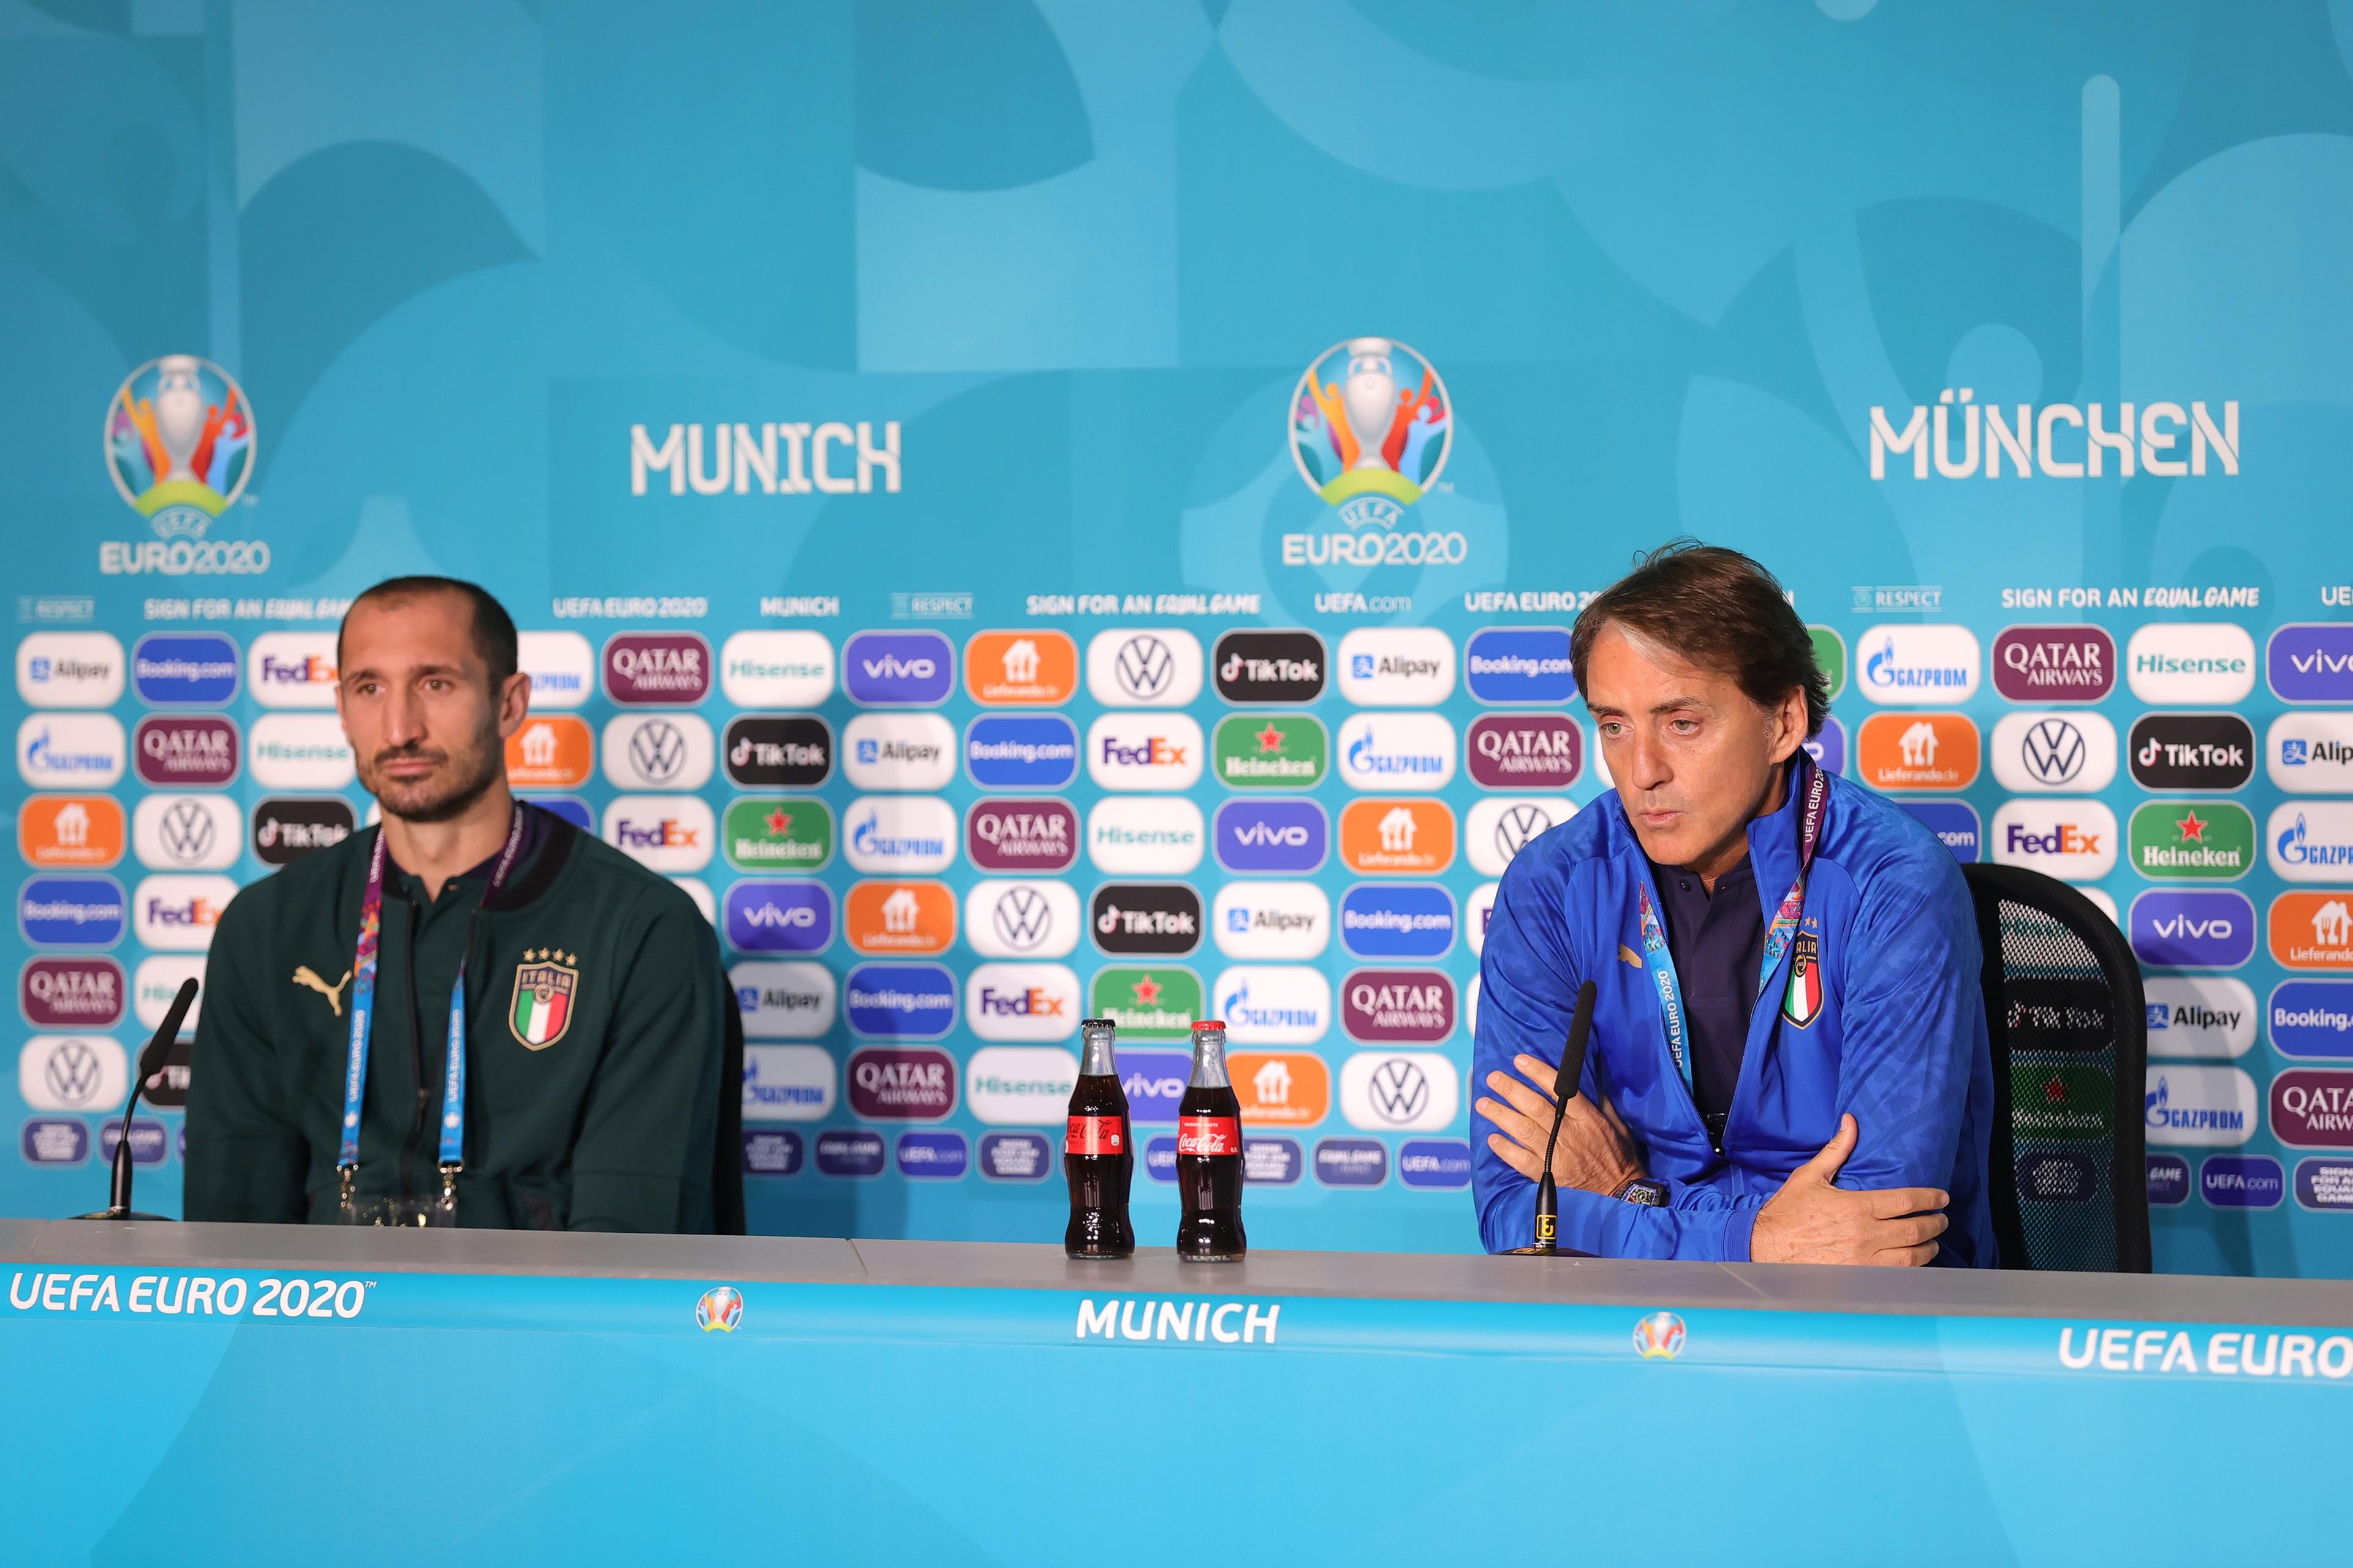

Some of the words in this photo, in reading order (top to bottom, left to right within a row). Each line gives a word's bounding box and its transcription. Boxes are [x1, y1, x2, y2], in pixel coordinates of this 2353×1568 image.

[1870, 387, 2240, 479] MÜNCHEN
[630, 420, 902, 496] MUNICH
[1341, 502, 1400, 526] UEFA
[553, 597, 604, 618] UEFA
[604, 597, 657, 618] EURO
[657, 597, 708, 618] 2020
[760, 596, 839, 616] MUNICH
[1026, 594, 1074, 615] SIGN
[1078, 594, 1119, 615] FOR
[1123, 594, 1152, 615] AN
[1154, 593, 1209, 615] EQUAL
[1210, 593, 1261, 615] GAME
[1314, 593, 1411, 613] UEFA.com
[1464, 591, 1519, 612] UEFA
[1520, 591, 1577, 612] EURO
[1876, 590, 1941, 607] RESPECT
[2001, 588, 2053, 608] SIGN
[2058, 588, 2101, 608] FOR
[2107, 588, 2138, 608] AN
[2143, 586, 2202, 608] EQUAL
[2204, 586, 2260, 608] GAME
[193, 598, 232, 620] FOR
[233, 598, 263, 620] AN
[137, 657, 235, 681] Booking.com
[613, 648, 700, 678] QATAR
[730, 659, 825, 678] Hisense
[862, 654, 936, 679] vivo
[1379, 656, 1441, 678] Alipay
[2004, 643, 2102, 673] QATAR
[2136, 653, 2246, 673] Hisense
[53, 660, 110, 680] Alipay
[1246, 660, 1319, 681] TikTok
[1897, 668, 1967, 687] GAZPROM
[2026, 668, 2104, 687] AIRWAYS
[634, 675, 703, 691] AIRWAYS
[143, 729, 230, 761] QATAR
[257, 740, 349, 759] Hisense
[754, 743, 825, 766] TikTok
[881, 742, 941, 765] Alipay
[969, 740, 1074, 763] Booking.com
[1102, 737, 1187, 765] FedEx
[1477, 730, 1571, 760] QATAR
[2164, 744, 2245, 767] TikTok
[2311, 741, 2353, 766] Alip
[1224, 756, 1316, 777] Heineken
[1373, 755, 1443, 773] GAZPROM
[1499, 755, 1572, 773] AIRWAYS
[1877, 767, 1959, 782] Lieferando.de
[1808, 780, 1824, 809] EURO
[617, 819, 699, 848] FedEx
[976, 813, 1067, 844] QATAR
[1097, 826, 1194, 845] Hisense
[1233, 820, 1309, 846] vivo
[1805, 810, 1817, 843] UEFA
[736, 838, 824, 861] Heineken
[2007, 824, 2101, 854] FedEx
[2142, 845, 2241, 867] Heineken
[23, 900, 120, 924] Booking.com
[743, 901, 817, 927] vivo
[1124, 911, 1195, 934] TikTok
[1254, 908, 1316, 930] Alipay
[1344, 908, 1452, 933] Booking.com
[2153, 913, 2232, 939] vivo
[1795, 940, 1817, 954] ALIA
[30, 971, 116, 1002] QATAR
[522, 970, 572, 989] ITALIA
[763, 988, 822, 1012] Alipay
[849, 989, 952, 1012] Booking.com
[980, 987, 1063, 1016] FedEx
[1351, 984, 1444, 1015] QATAR
[1372, 1010, 1446, 1029] AIRWAYS
[1667, 1002, 1681, 1036] EURO
[2173, 1005, 2241, 1031] Alipay
[856, 1062, 946, 1094] QATAR
[975, 1077, 1072, 1096] Hisense
[2172, 1109, 2244, 1130] GAZPROM
[2206, 1173, 2279, 1191] UEFA.com
[9, 1273, 121, 1312] UEFA
[128, 1276, 248, 1316] EURO
[1075, 1298, 1281, 1344] MUNICH
[2058, 1327, 2199, 1373] UEFA
[2207, 1332, 2353, 1378] EURO
